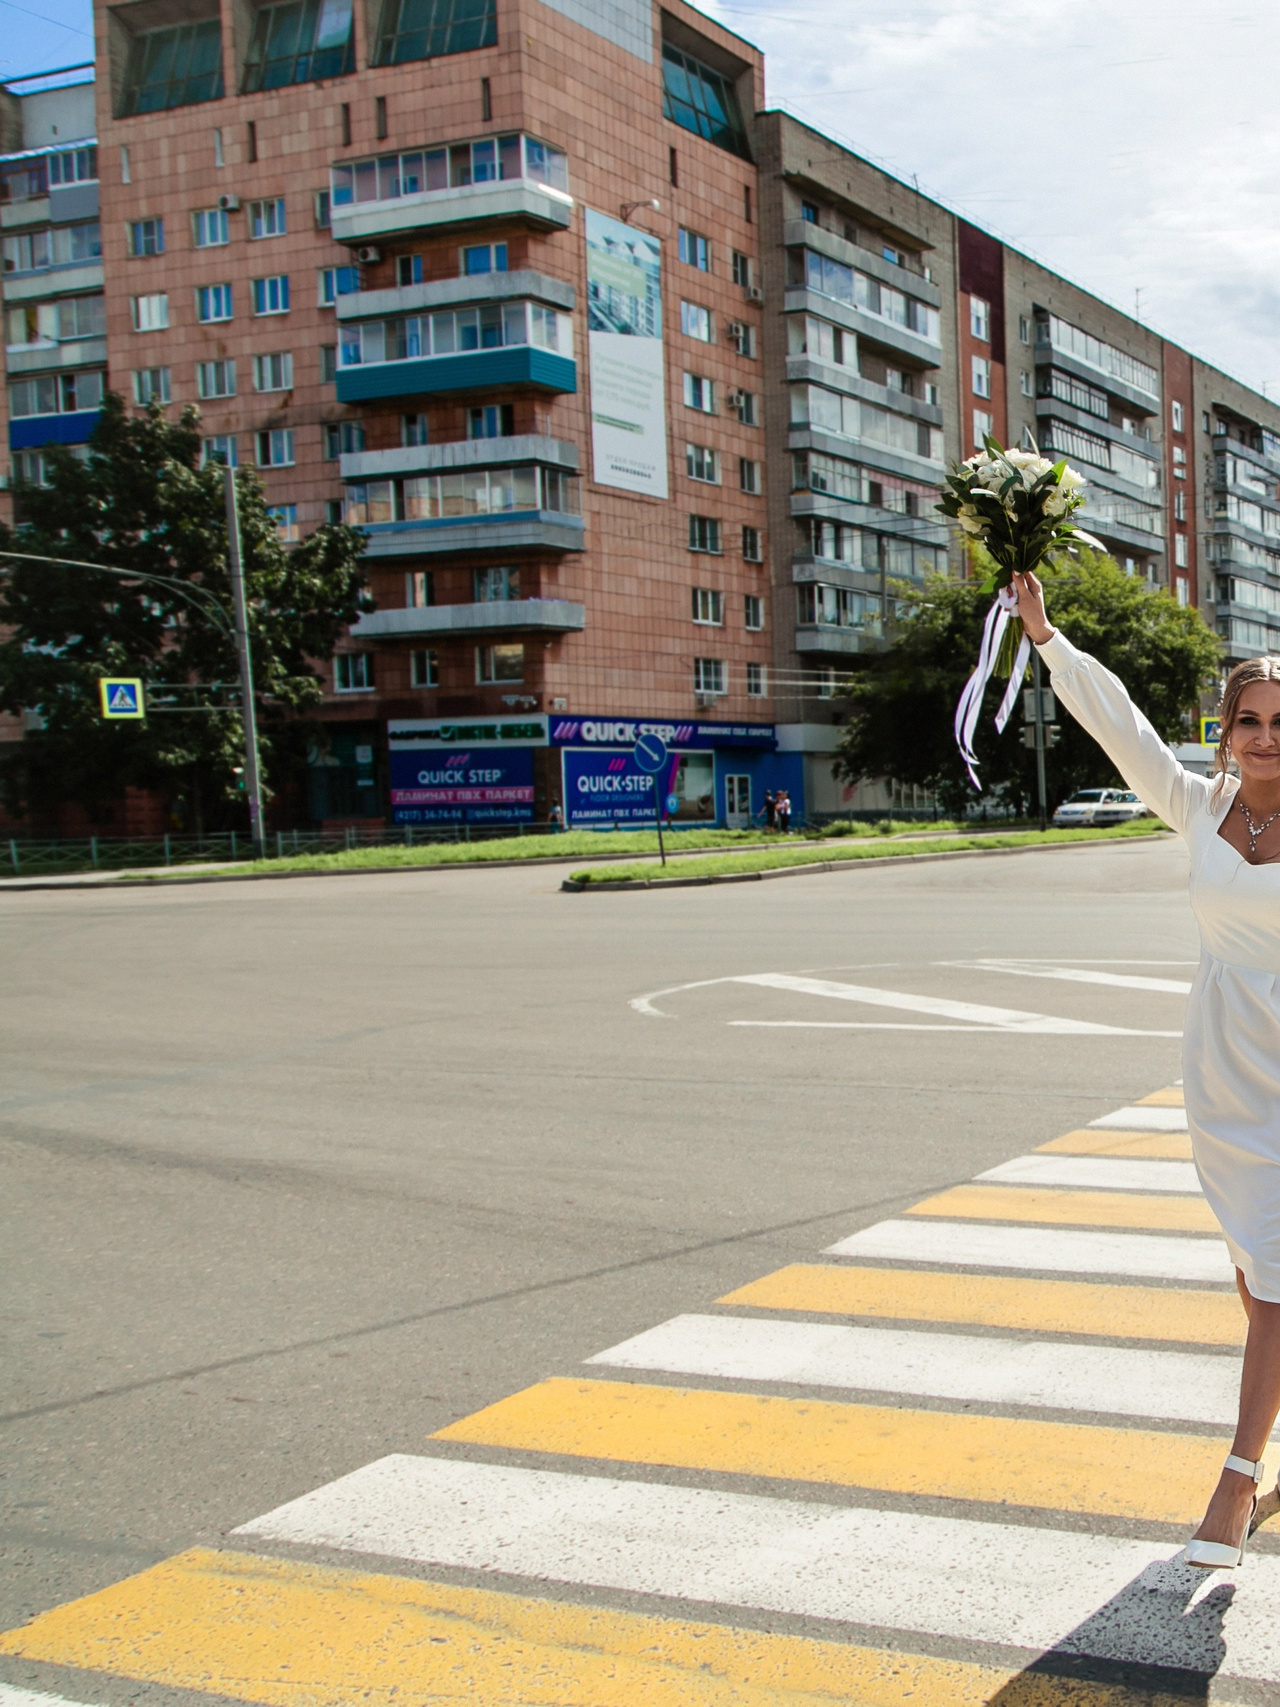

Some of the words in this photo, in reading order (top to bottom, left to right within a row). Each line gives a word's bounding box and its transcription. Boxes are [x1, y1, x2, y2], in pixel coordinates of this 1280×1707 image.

[417, 770, 465, 784] QUICK
[468, 769, 502, 783] STEP
[396, 791, 454, 802] ЛАМИНАТ
[457, 790, 481, 801] ПВХ
[485, 789, 530, 800] ПАРКЕТ
[572, 808, 612, 819] ЛАМИНАТ
[613, 807, 631, 817] ПВХ
